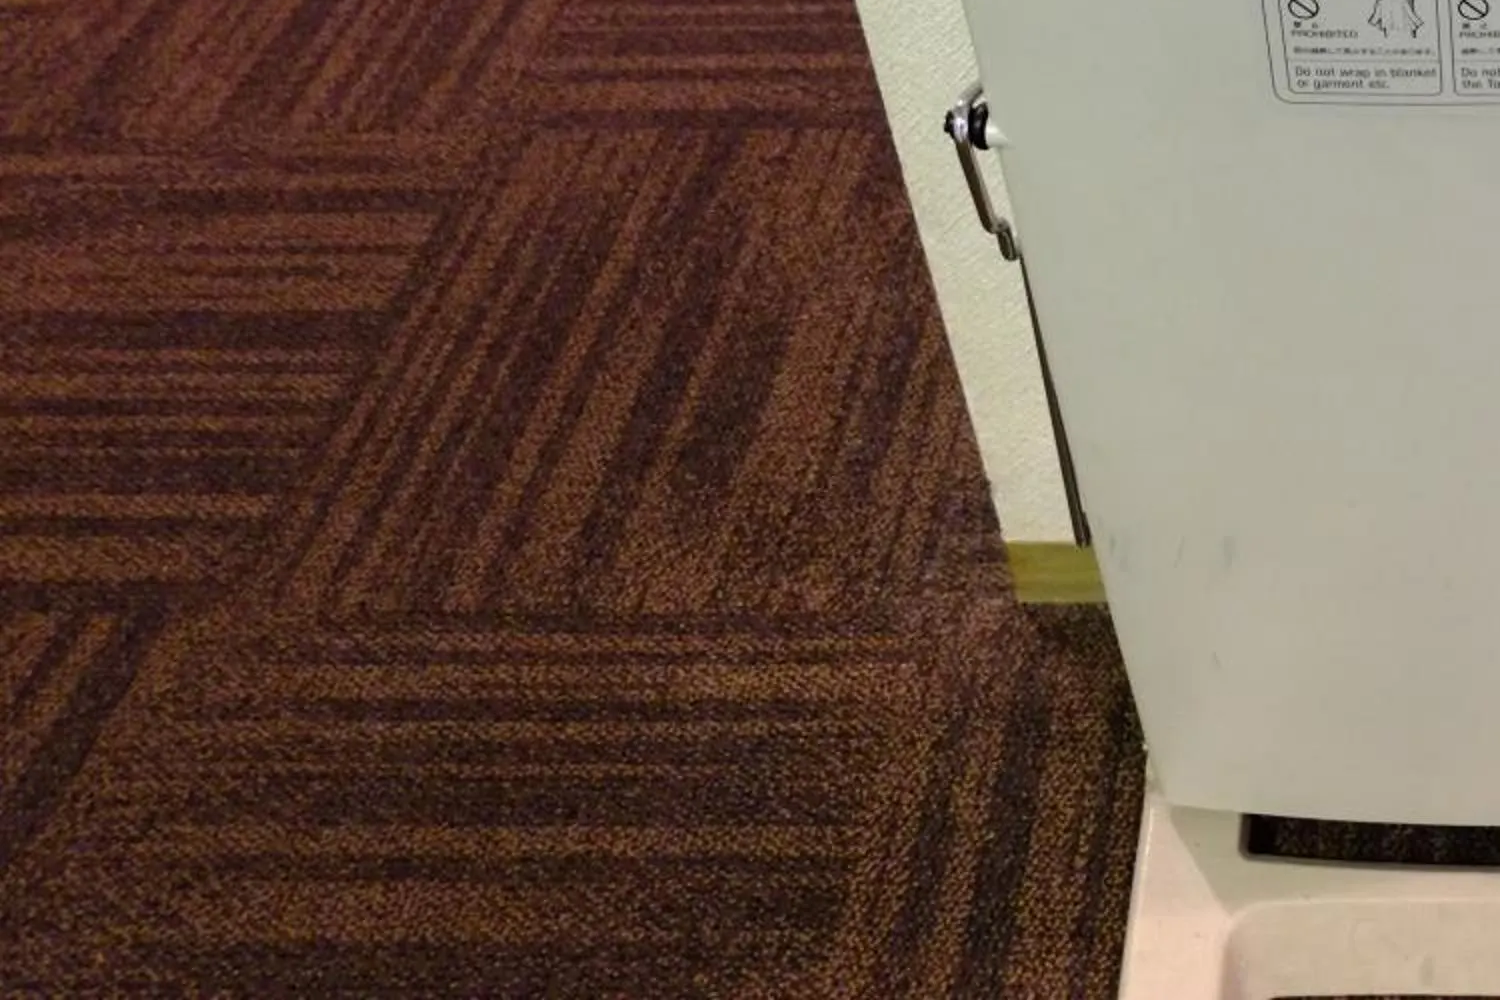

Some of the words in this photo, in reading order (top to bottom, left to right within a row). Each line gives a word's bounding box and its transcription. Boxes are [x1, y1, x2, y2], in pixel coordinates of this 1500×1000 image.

[1295, 65, 1310, 77] Do
[1315, 65, 1336, 77] not
[1340, 68, 1371, 79] wrap
[1374, 67, 1387, 77] in
[1389, 66, 1438, 78] blanket
[1461, 67, 1478, 78] Do
[1313, 78, 1364, 91] garment
